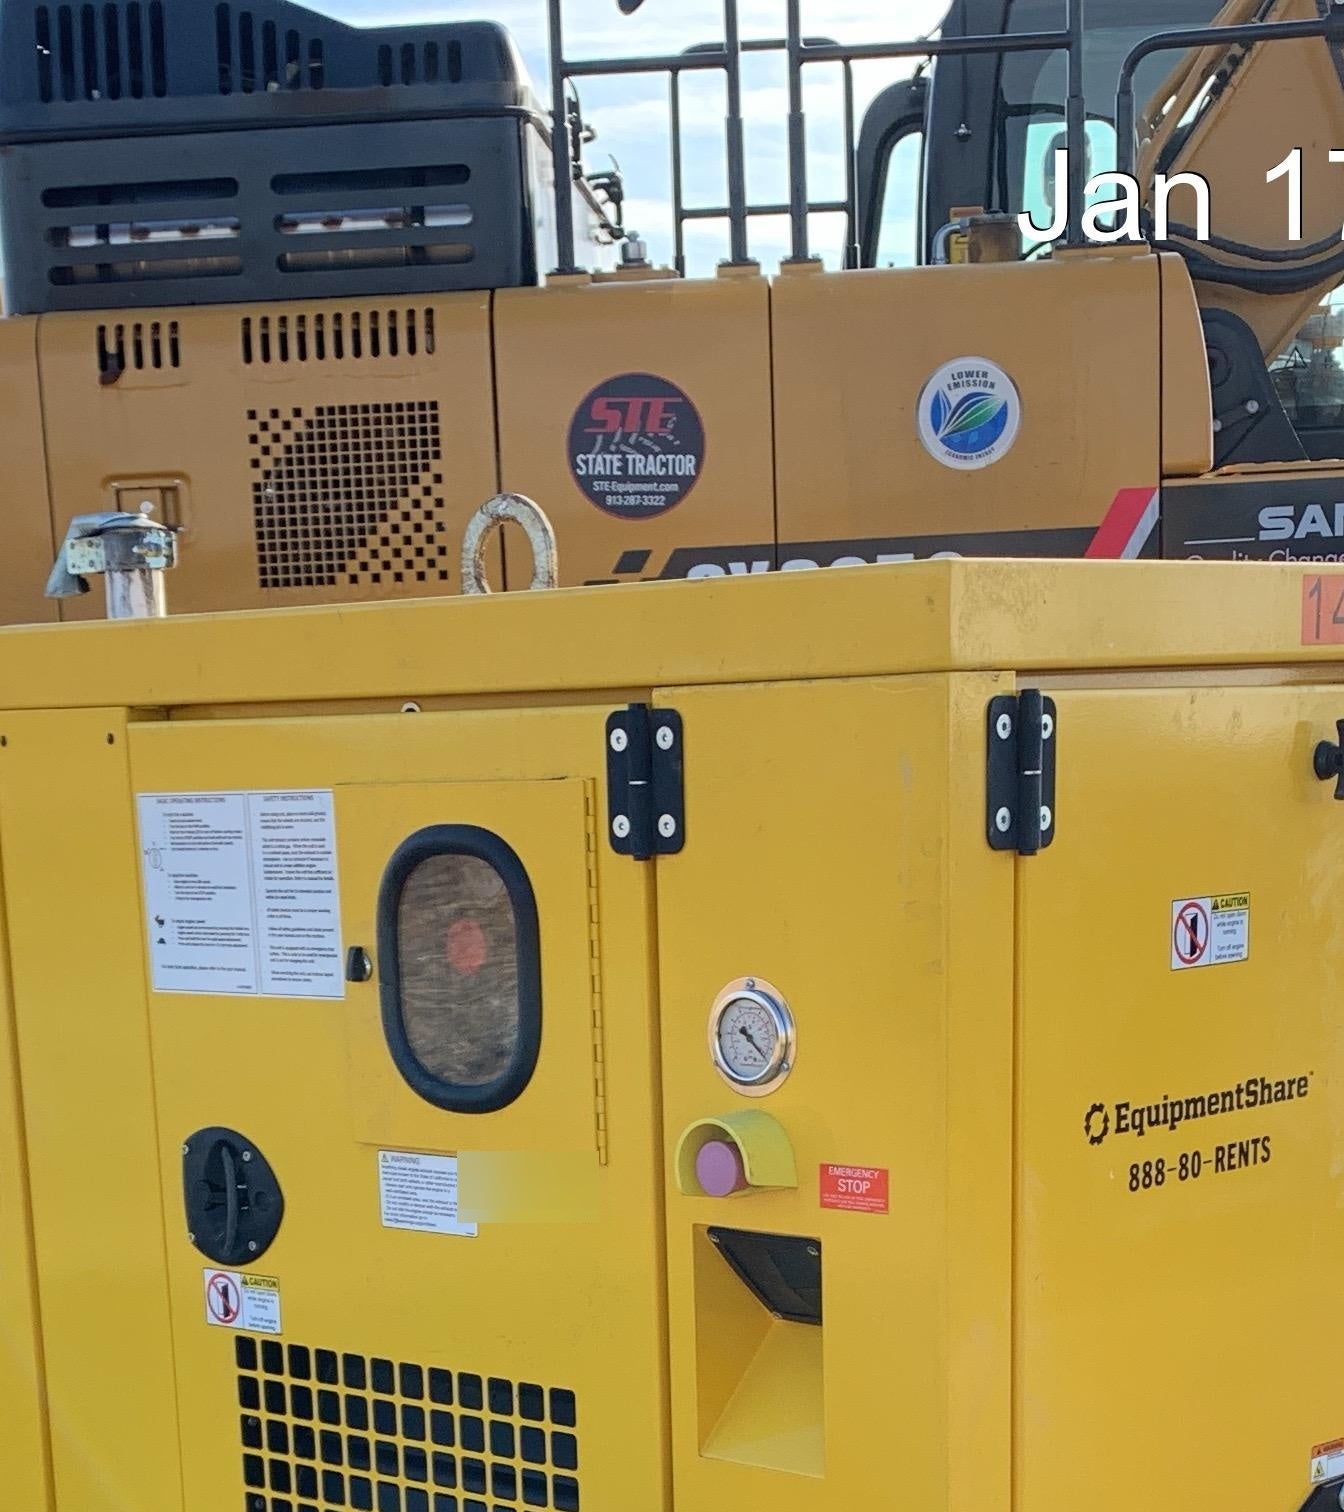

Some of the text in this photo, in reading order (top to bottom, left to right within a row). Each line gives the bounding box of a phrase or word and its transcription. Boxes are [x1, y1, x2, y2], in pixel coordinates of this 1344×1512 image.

[951, 370, 989, 381] LOWER
[947, 379, 996, 391] EMISSION
[584, 396, 682, 433] STE
[576, 453, 696, 476] STATE TRACTOR
[1220, 895, 1248, 909] CAUTION
[1113, 1074, 1308, 1137] EquipmentShare
[1128, 1135, 1271, 1193] 888-80-RENTS
[828, 1166, 880, 1179] EMERGENCY
[837, 1178, 871, 1194] STOP
